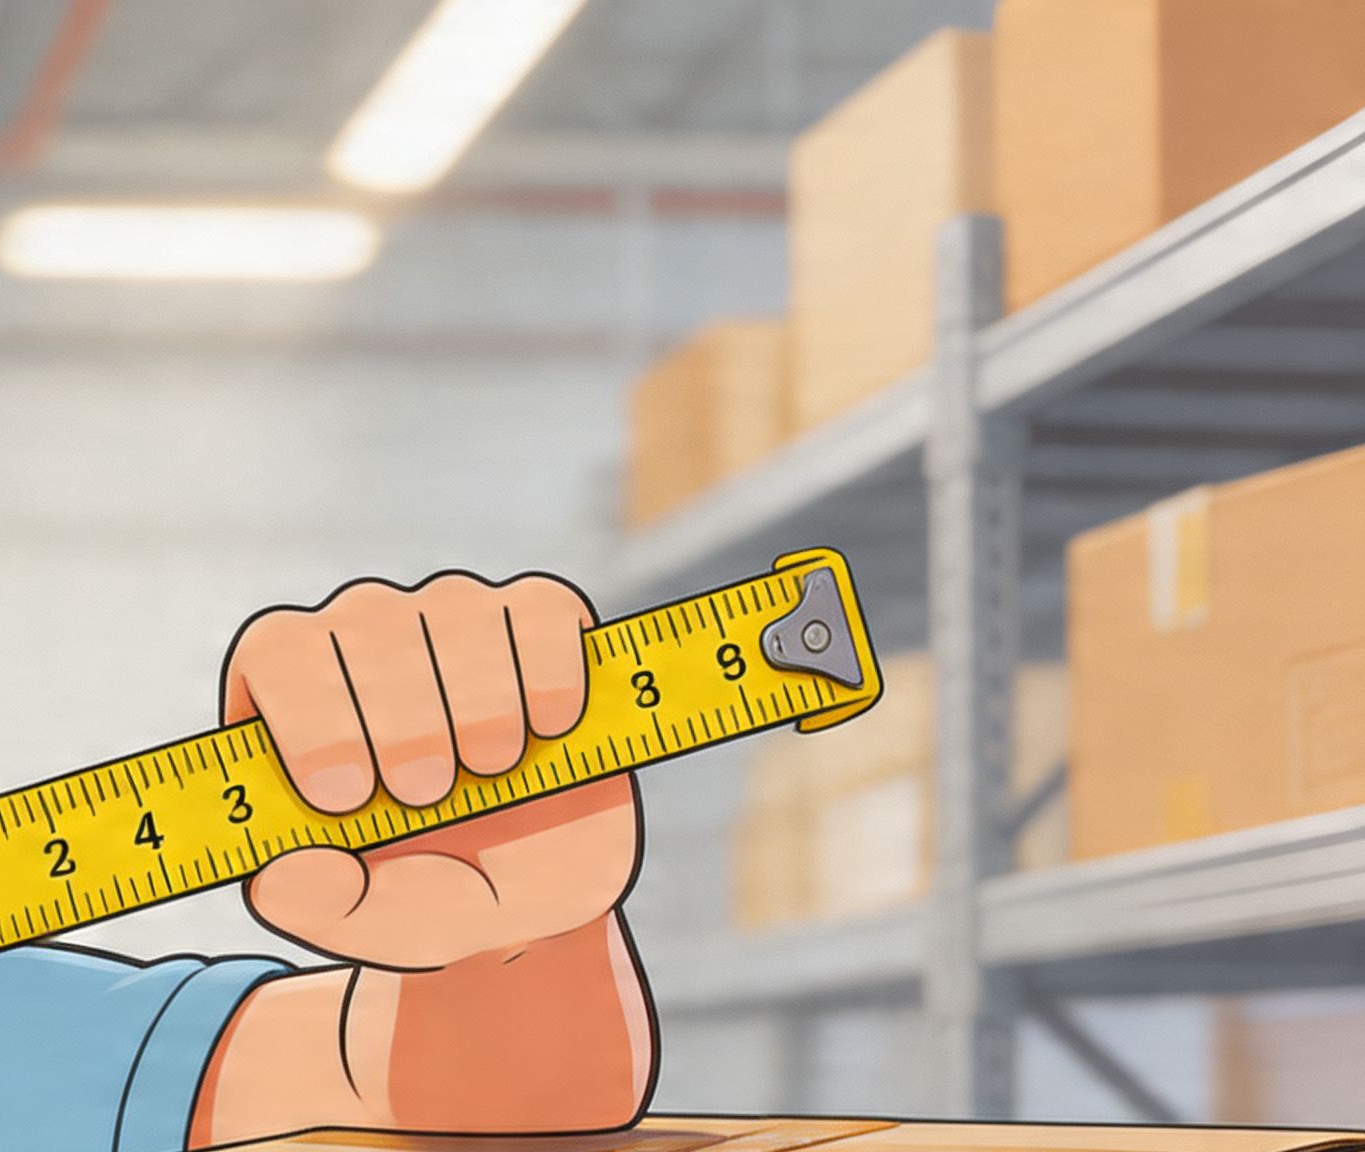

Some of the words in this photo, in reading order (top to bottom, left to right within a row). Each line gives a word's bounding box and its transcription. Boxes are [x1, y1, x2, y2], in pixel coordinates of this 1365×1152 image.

[43, 838, 77, 878] 2
[133, 811, 165, 850] 4
[221, 784, 254, 824] 3
